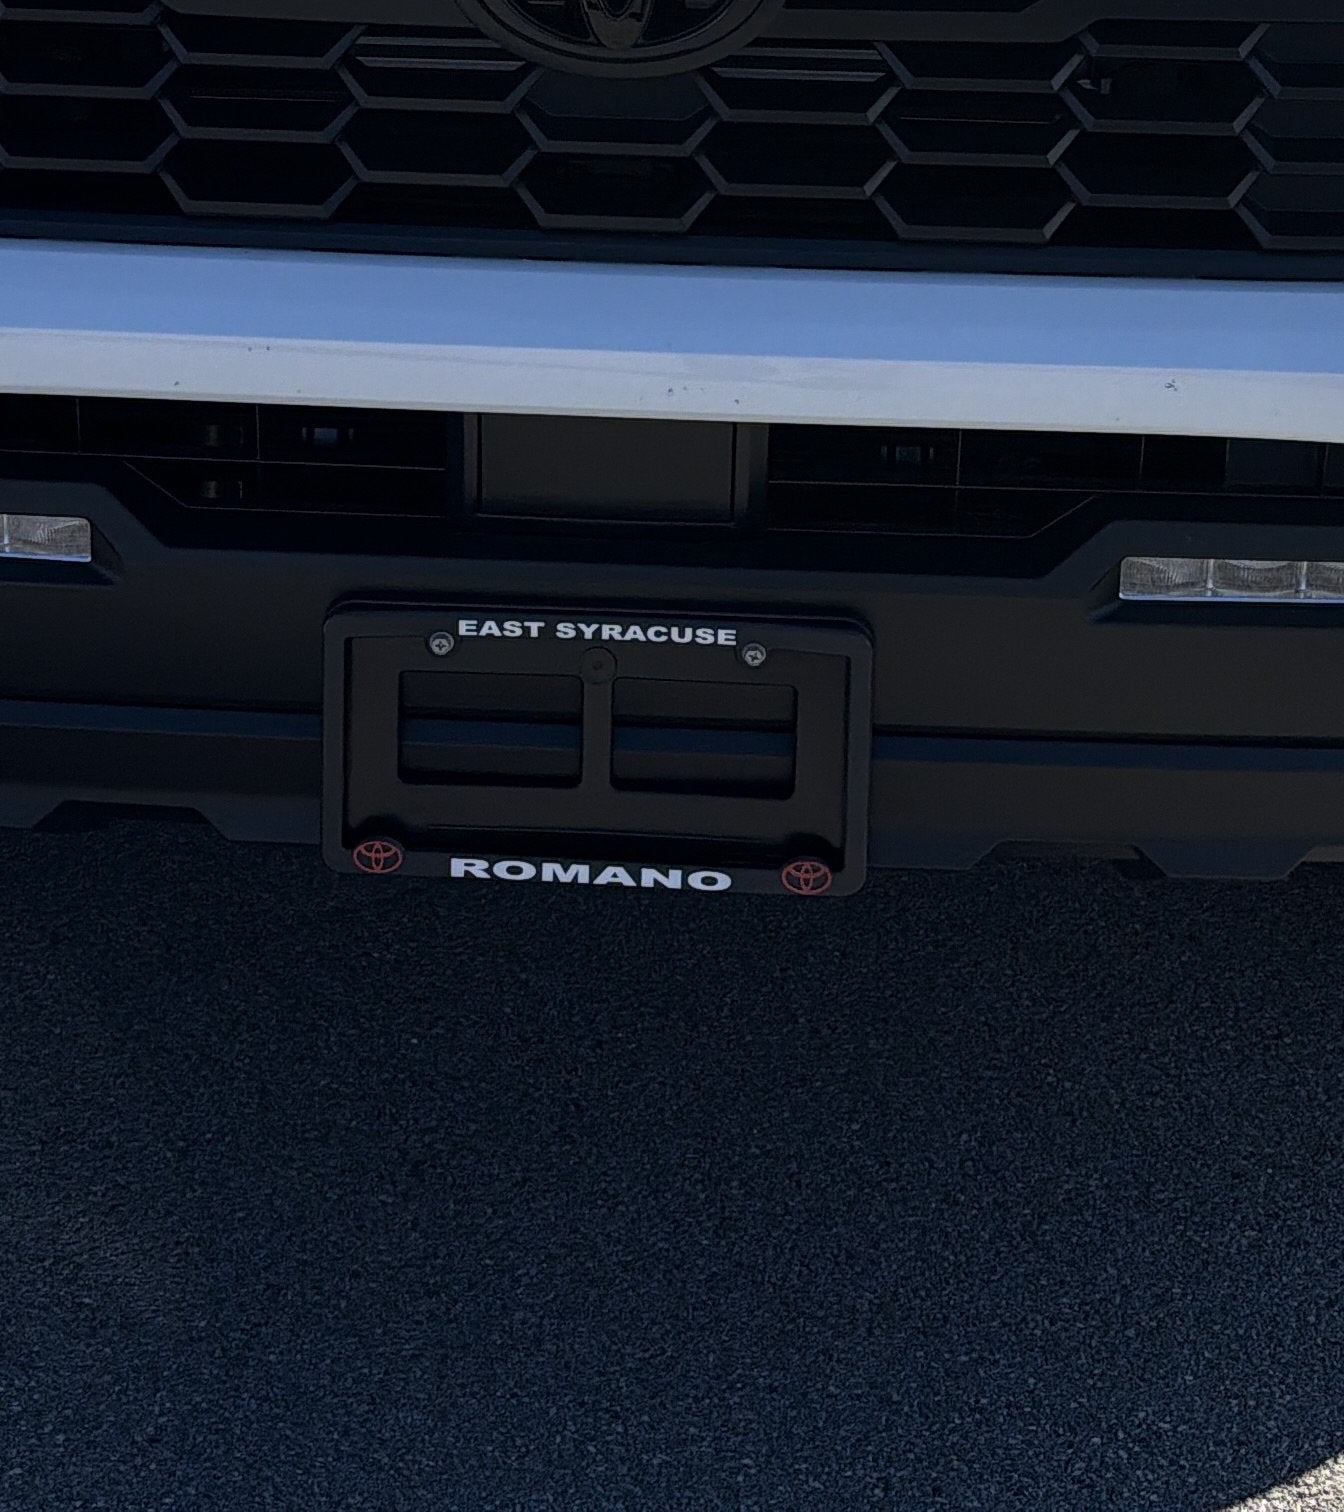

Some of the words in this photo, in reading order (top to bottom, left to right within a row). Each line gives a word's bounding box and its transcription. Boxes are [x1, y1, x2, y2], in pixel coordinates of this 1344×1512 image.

[457, 618, 545, 638] EAST
[555, 621, 738, 646] SYRACUSE
[449, 857, 733, 892] ROMANO
